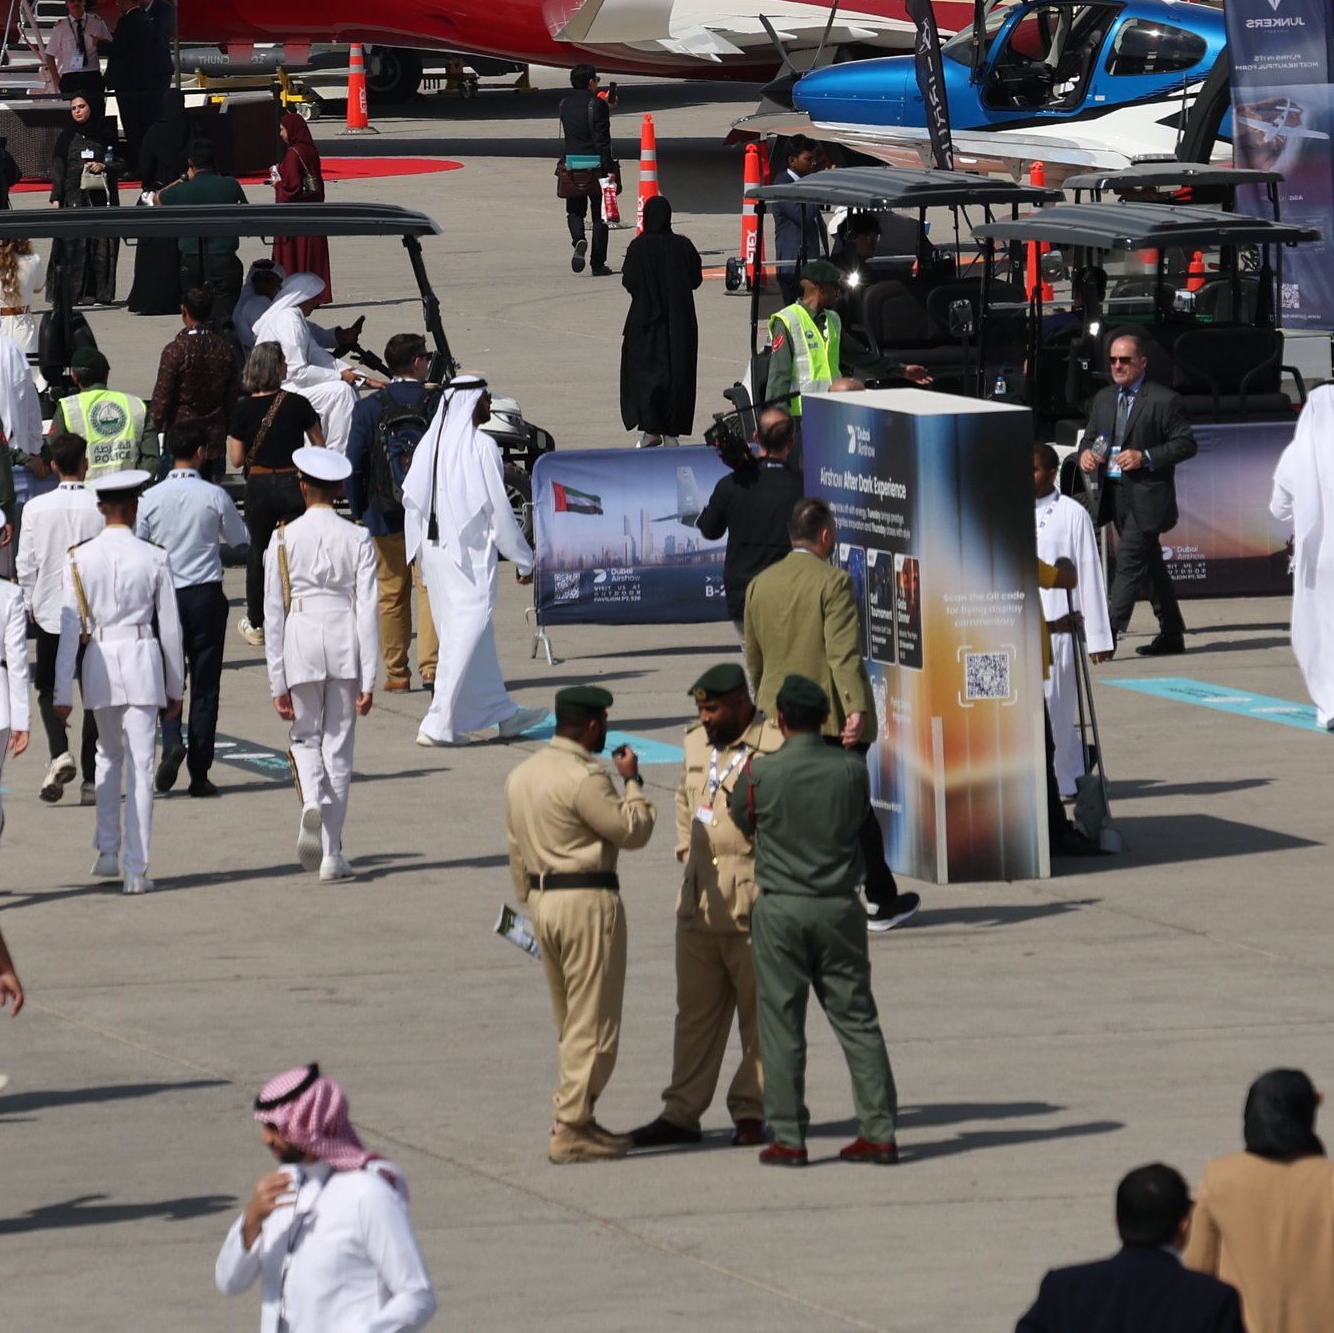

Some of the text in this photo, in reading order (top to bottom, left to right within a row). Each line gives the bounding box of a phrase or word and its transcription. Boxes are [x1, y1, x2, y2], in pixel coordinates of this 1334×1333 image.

[857, 426, 870, 442] Dubai
[857, 443, 875, 458] Airshow
[94, 450, 131, 465] POLICE
[820, 466, 907, 502] Airshow After Dark Experience
[610, 567, 634, 575] Dubai
[610, 575, 641, 583] Airshow
[943, 591, 1026, 603] Scan the QR code
[946, 603, 1023, 616] for flying display
[954, 617, 1015, 628] commentary
